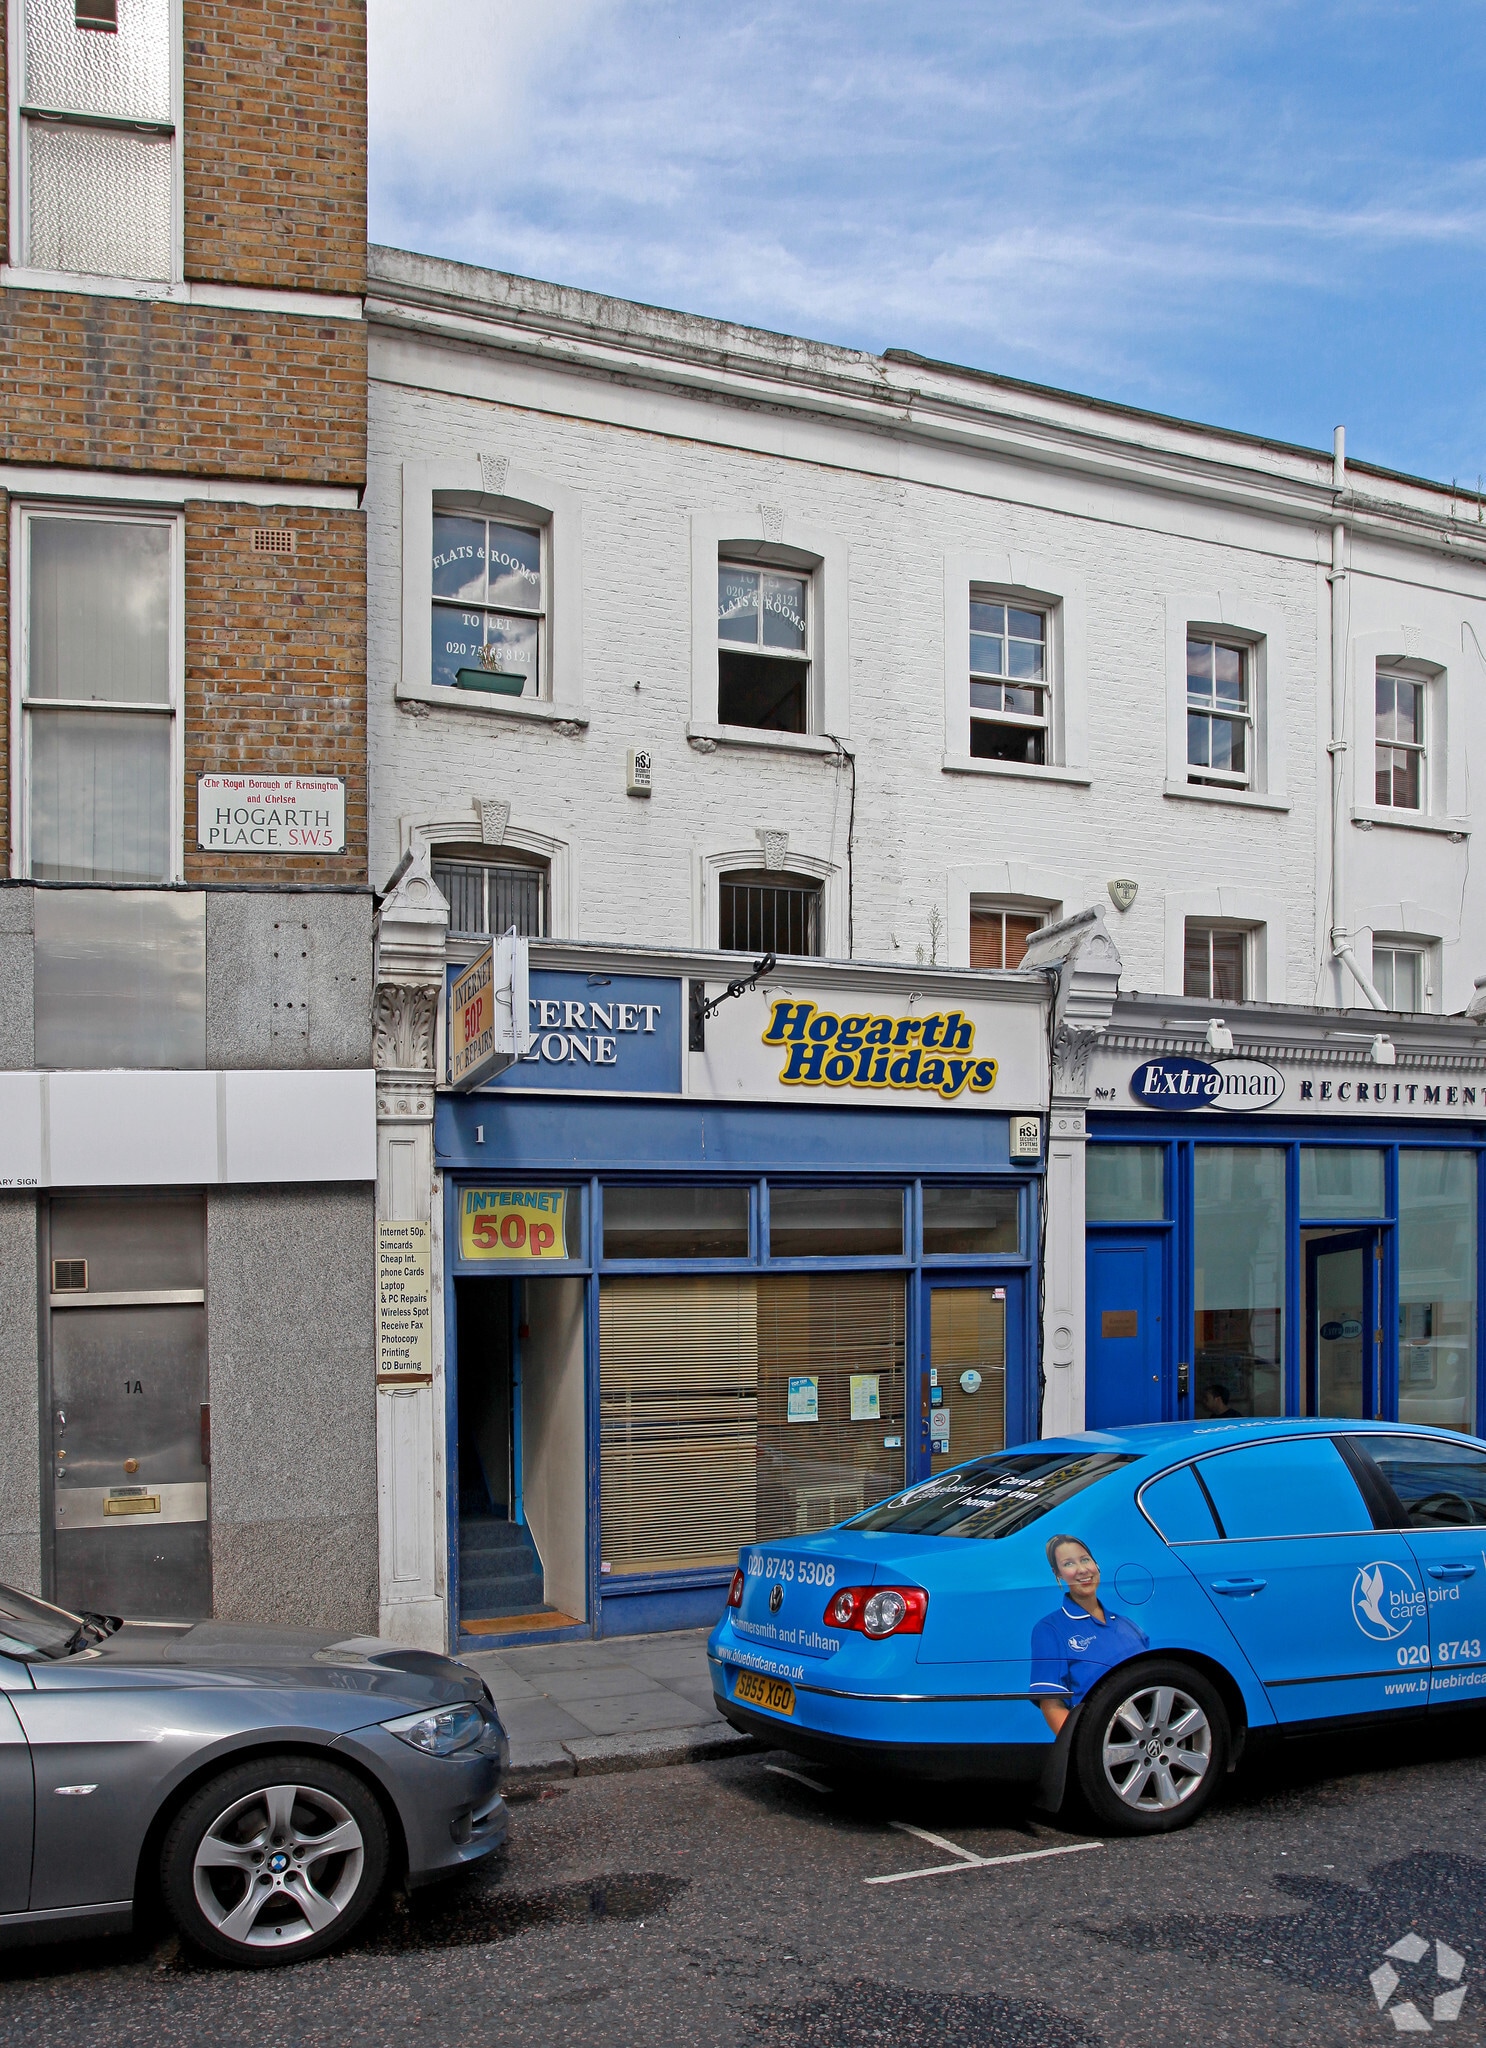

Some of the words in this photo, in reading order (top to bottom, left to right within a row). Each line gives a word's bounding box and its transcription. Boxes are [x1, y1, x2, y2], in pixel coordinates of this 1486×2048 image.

[432, 545, 473, 570] FLATS
[476, 547, 485, 559] &
[491, 549, 538, 585] ROOMS
[462, 613, 480, 628] TO
[489, 619, 512, 631] LET
[752, 599, 760, 607] &
[765, 600, 806, 632] ROOMS
[446, 641, 466, 655] 020
[506, 649, 531, 663] 8121
[635, 755, 651, 769] RSJ
[204, 779, 220, 788] The
[222, 779, 245, 791] Royal
[248, 780, 281, 791] Borough
[284, 780, 293, 789] of
[296, 780, 339, 792] Kensington
[247, 795, 261, 804] and
[265, 795, 296, 804] Chelsea
[216, 807, 330, 827] HOGARTH
[209, 827, 282, 847] PLACE,
[288, 829, 333, 847] S.W.5
[455, 957, 493, 1013] INTERNET
[464, 997, 483, 1043] 50P
[765, 1002, 973, 1053] Hogarth
[464, 1026, 494, 1069] REPAIRS
[782, 1042, 996, 1095] Holidays
[475, 1125, 486, 1143] 1
[1019, 1126, 1038, 1137] RSJ
[16, 1178, 38, 1186] SIGN
[466, 1191, 562, 1214] INTERNET
[380, 1227, 408, 1237] Internet
[410, 1226, 426, 1239] 50p.
[472, 1213, 555, 1255] 50p
[380, 1240, 413, 1250] Simcards
[380, 1254, 403, 1266] Cheap
[405, 1254, 417, 1263] Int.
[380, 1267, 402, 1279] phone
[404, 1266, 425, 1277] Cards
[380, 1281, 405, 1293] Laptop
[381, 1294, 387, 1304] &
[388, 1294, 399, 1304] PC
[400, 1294, 427, 1306] Repairs
[381, 1307, 411, 1317] Wireless
[412, 1306, 429, 1318] Spot
[381, 1320, 409, 1331] Receive
[410, 1320, 424, 1330] Fax
[381, 1334, 419, 1346] Photocopy
[381, 1348, 410, 1359] Printing
[381, 1360, 392, 1371] CD
[393, 1360, 422, 1372] Burning
[124, 1381, 143, 1394] 1A
[1000, 1476, 1030, 1486] Care
[975, 1487, 1010, 1497] your
[1008, 1490, 1038, 1501] own
[959, 1497, 996, 1508] home
[747, 1554, 764, 1577] 020
[765, 1557, 795, 1582] 8743
[797, 1560, 836, 1588] 5308
[1390, 1604, 1426, 1619] care
[778, 1628, 796, 1644] and
[798, 1629, 840, 1652] Fulham
[1396, 1645, 1430, 1666] 020
[1438, 1639, 1481, 1662] 8743
[718, 1646, 805, 1680] www.bluebirdcare.co.uk
[765, 1682, 791, 1710] XGO
